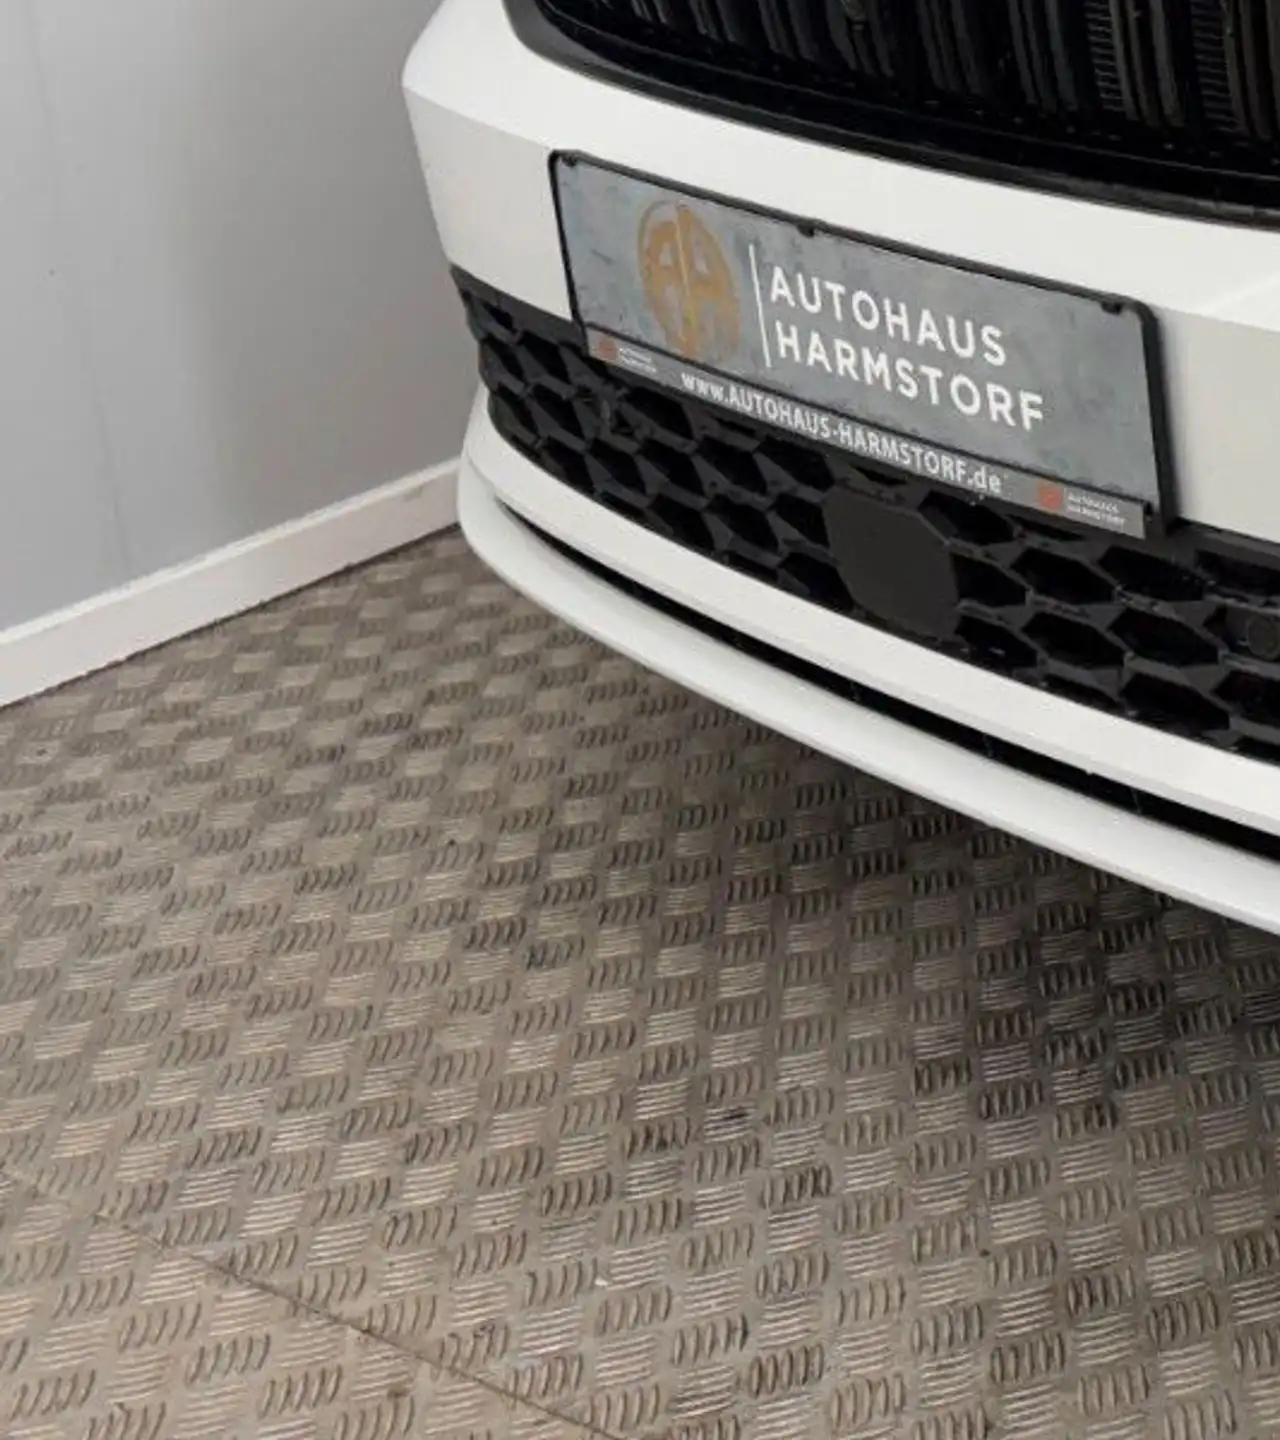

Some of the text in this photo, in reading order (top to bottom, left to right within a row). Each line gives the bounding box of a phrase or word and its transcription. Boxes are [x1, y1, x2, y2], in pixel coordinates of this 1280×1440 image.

[770, 265, 1007, 368] AUTOHAUS
[680, 371, 1003, 494] www.AUTOHAUS-HARMSTORF.de
[775, 318, 1046, 433] HARMSTORF
